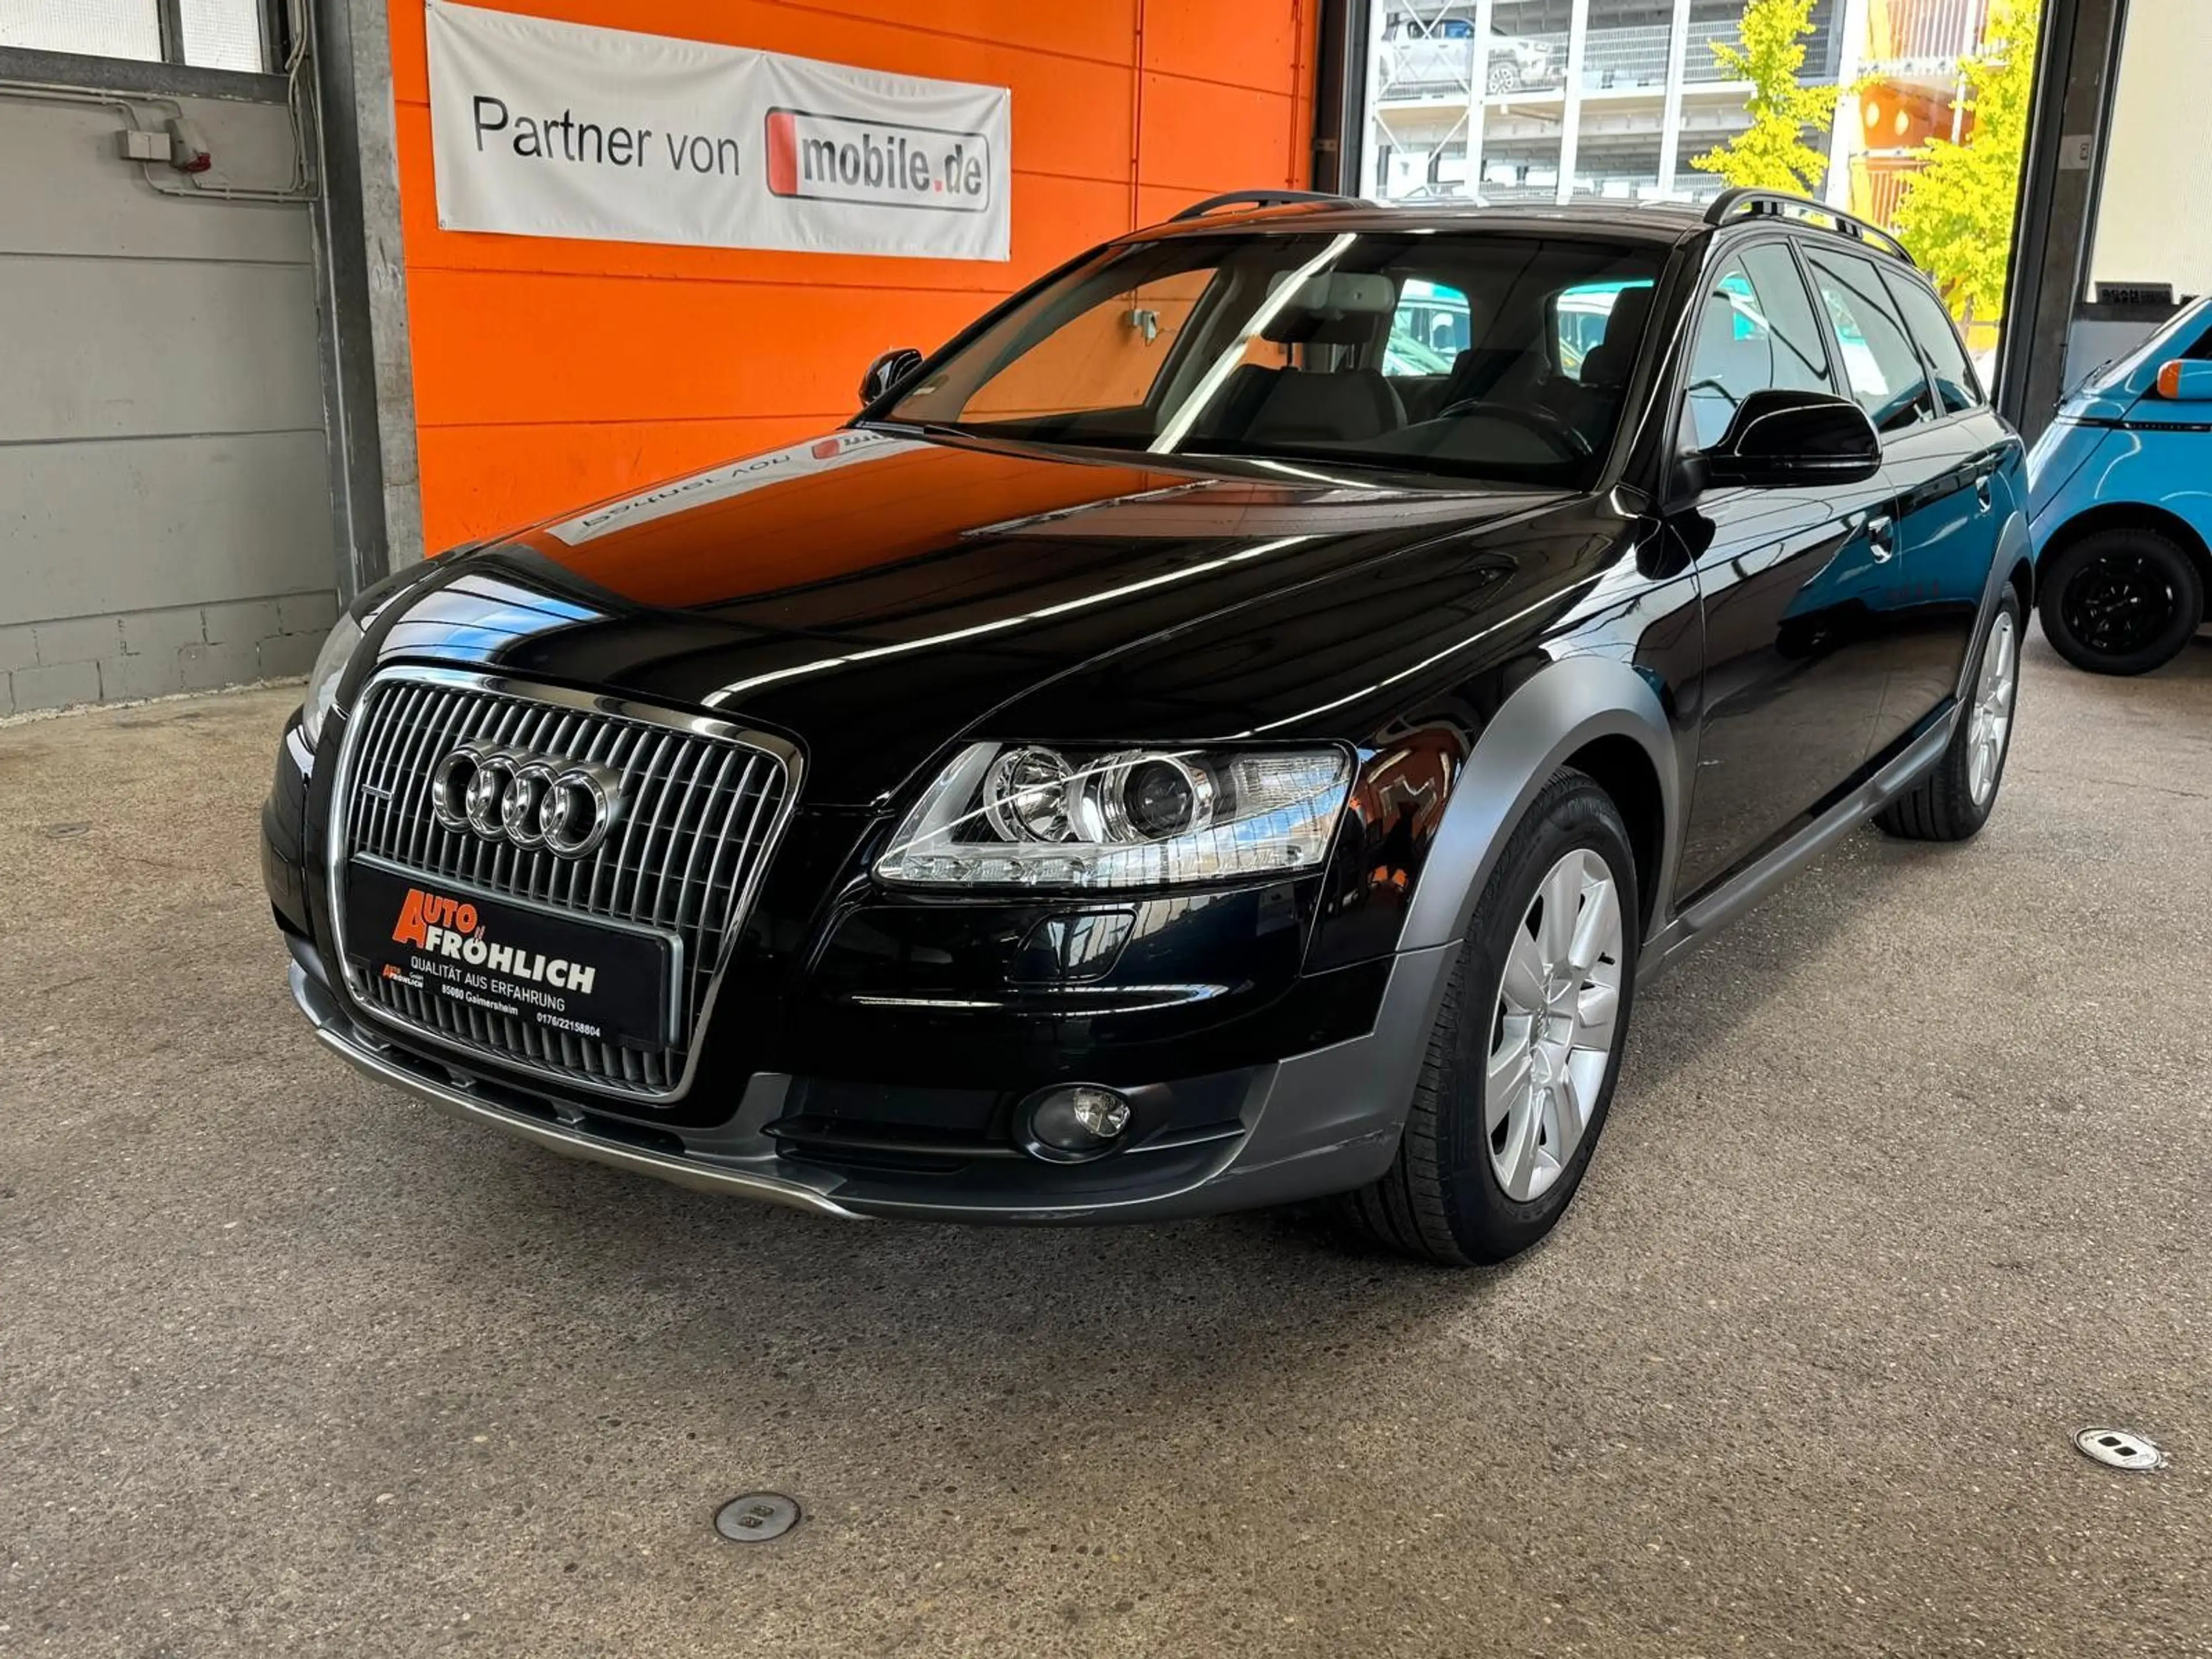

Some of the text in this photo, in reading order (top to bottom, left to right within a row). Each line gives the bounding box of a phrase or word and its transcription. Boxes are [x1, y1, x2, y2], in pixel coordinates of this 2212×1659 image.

[473, 95, 982, 195] Partner von mobile.de
[392, 888, 478, 949] AUTO
[410, 955, 565, 1012] QUALITÄT AUS ERFAHRUNG
[425, 925, 596, 994] FRÖHLICH
[465, 991, 518, 1016] Gaimersheim
